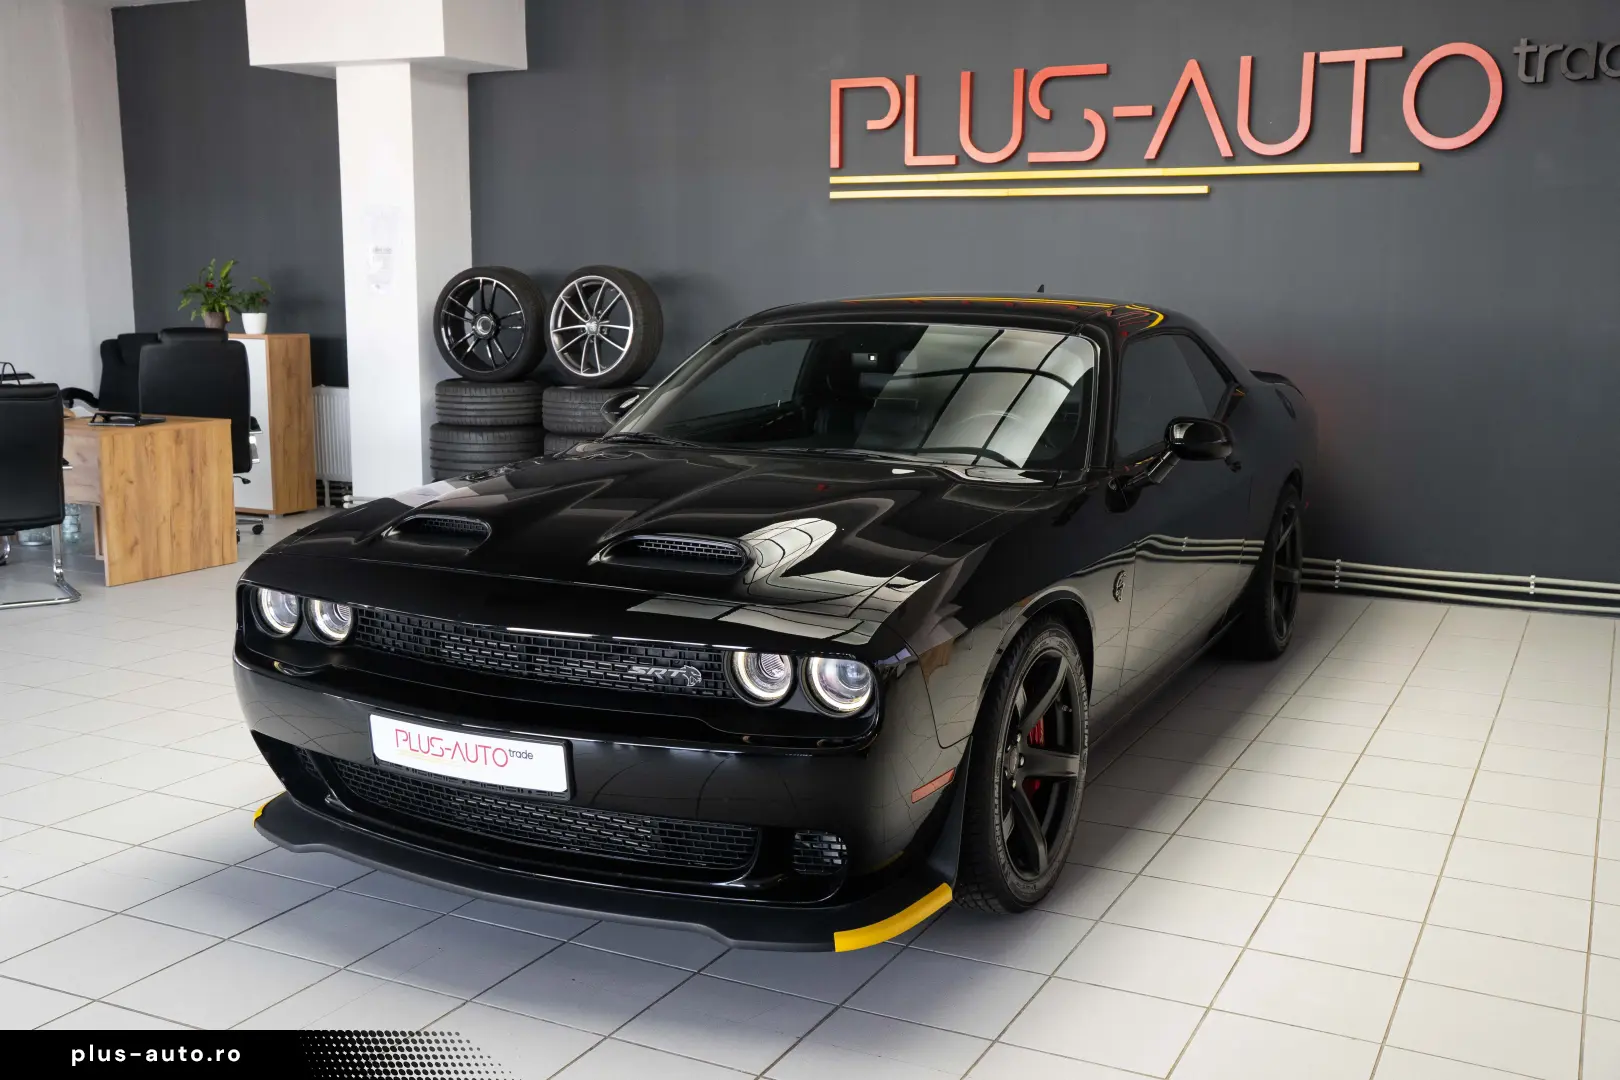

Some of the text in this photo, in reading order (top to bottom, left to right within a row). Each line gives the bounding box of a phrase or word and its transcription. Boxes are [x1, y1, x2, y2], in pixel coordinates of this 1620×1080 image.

[830, 41, 1503, 169] PLUS-AUTO
[627, 665, 686, 680] SRT
[395, 728, 534, 768] PLUS-AUTO trade
